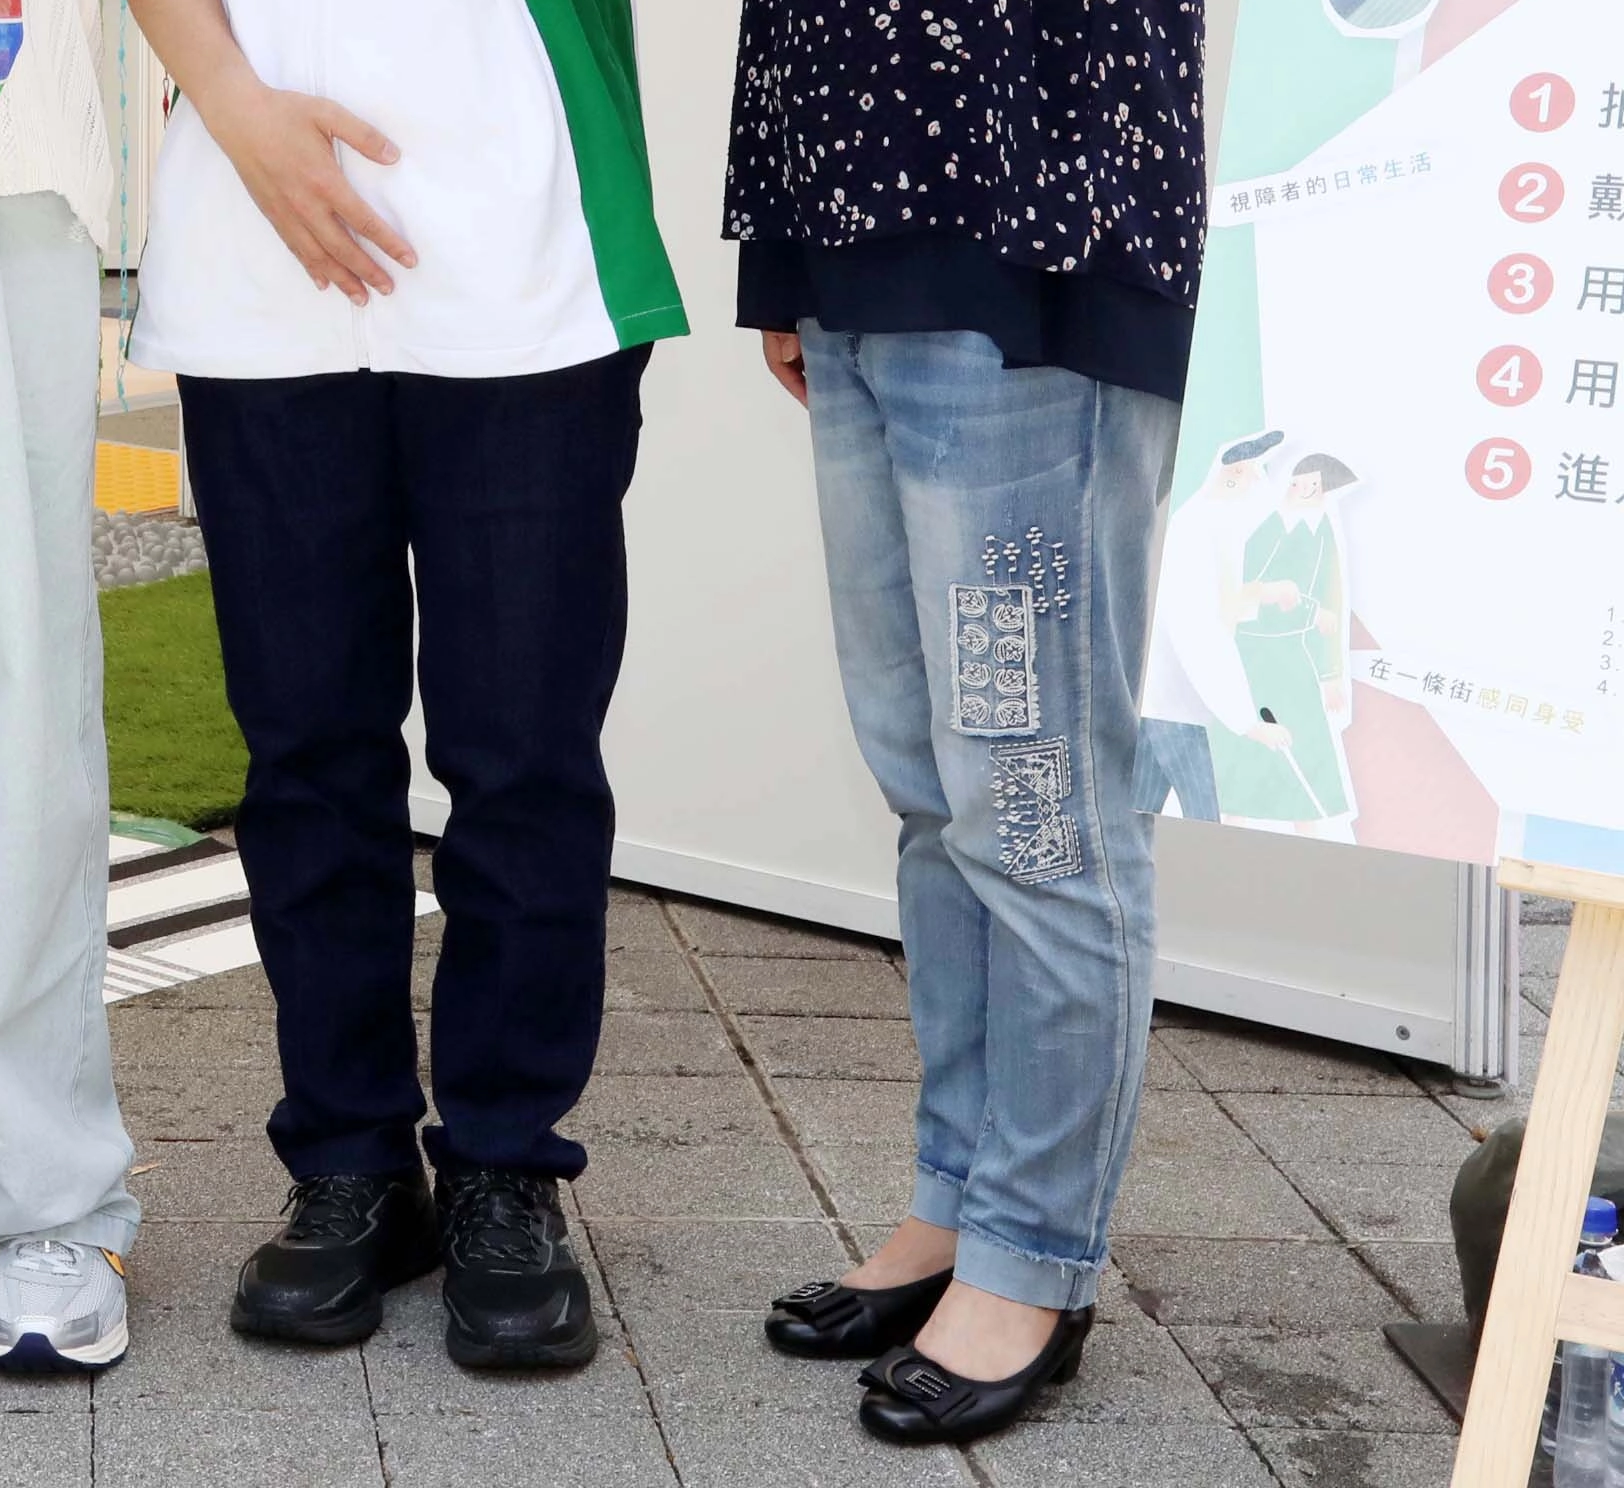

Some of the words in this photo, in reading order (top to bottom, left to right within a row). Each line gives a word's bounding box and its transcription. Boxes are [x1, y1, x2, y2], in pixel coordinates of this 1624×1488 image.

[1528, 81, 1553, 124] 1
[1229, 151, 1433, 213] 視障者的日常生活
[1514, 171, 1549, 215] 2
[1503, 262, 1535, 305] 3
[1576, 265, 1624, 315] 用
[1489, 354, 1525, 399] 4
[1565, 358, 1618, 409] 用
[1480, 446, 1516, 491] 5
[1554, 451, 1624, 504] 進
[1368, 657, 1586, 736] 在一條街感同身受
